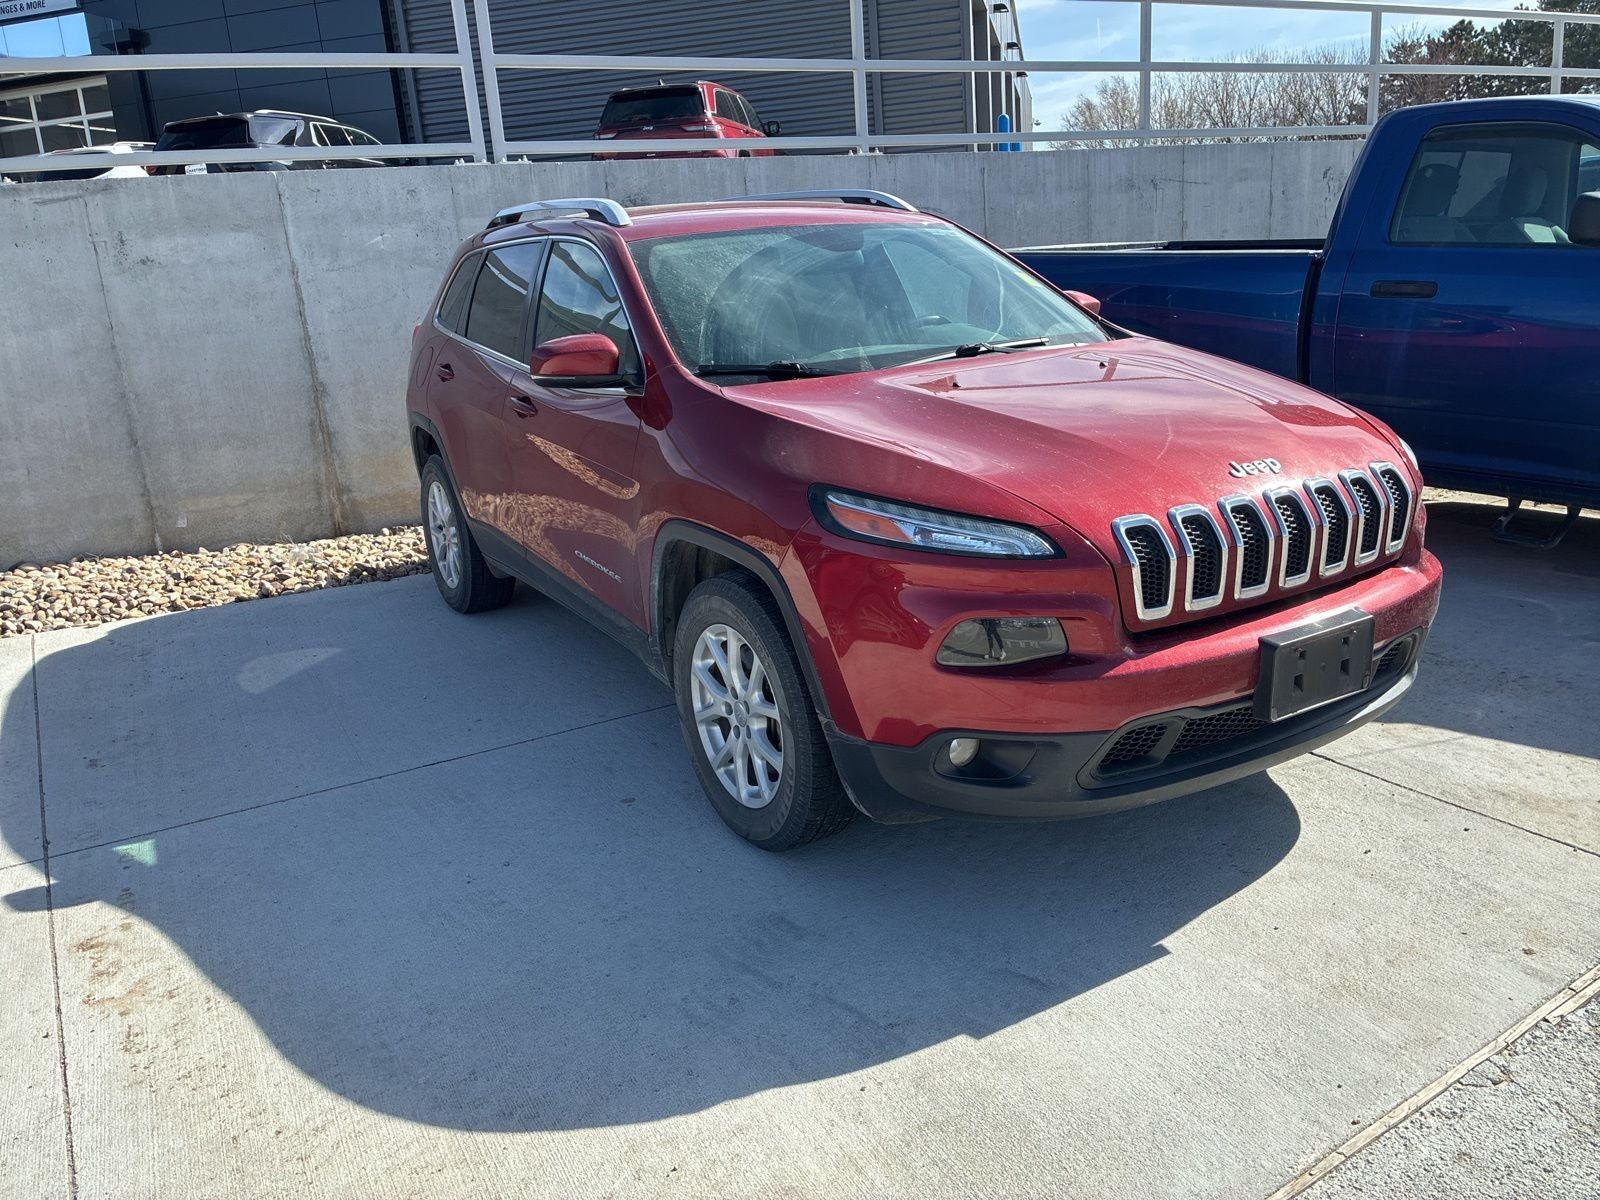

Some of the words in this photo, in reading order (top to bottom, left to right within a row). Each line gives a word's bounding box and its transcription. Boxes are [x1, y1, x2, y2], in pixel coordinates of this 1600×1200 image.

[19, 3, 25, 11] &
[26, 0, 46, 10] MORE
[1228, 458, 1281, 478] Jeep
[575, 550, 622, 583] CHEROKEE
